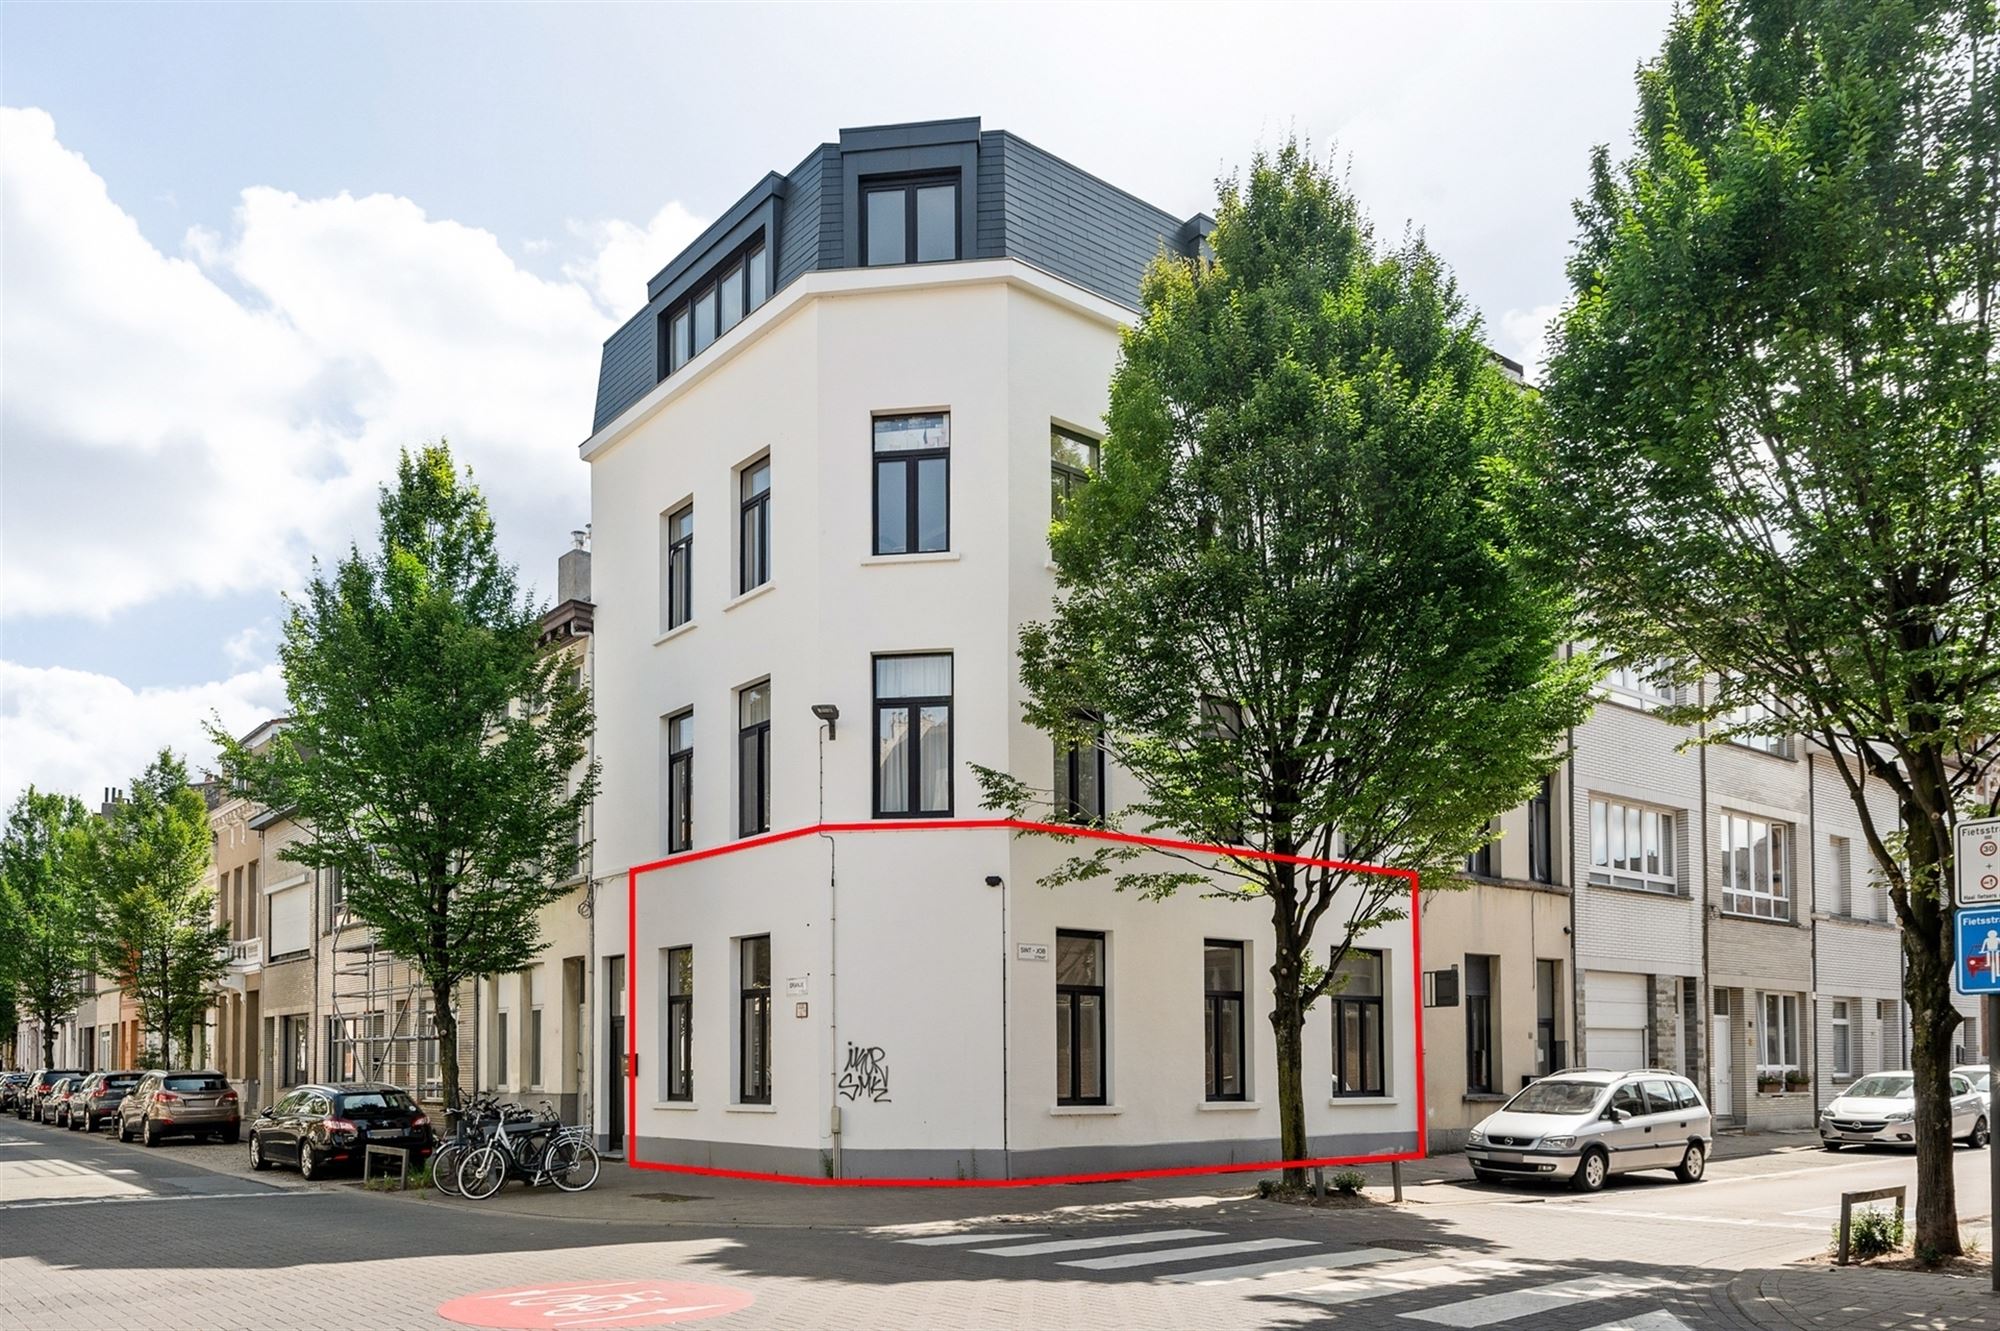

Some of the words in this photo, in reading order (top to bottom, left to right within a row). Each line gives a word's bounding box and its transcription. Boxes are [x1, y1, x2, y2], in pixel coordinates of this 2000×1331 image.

[1962, 826, 2000, 837] Fietsstr
[1983, 845, 1994, 853] 30
[1962, 916, 2000, 926] Fietsstr
